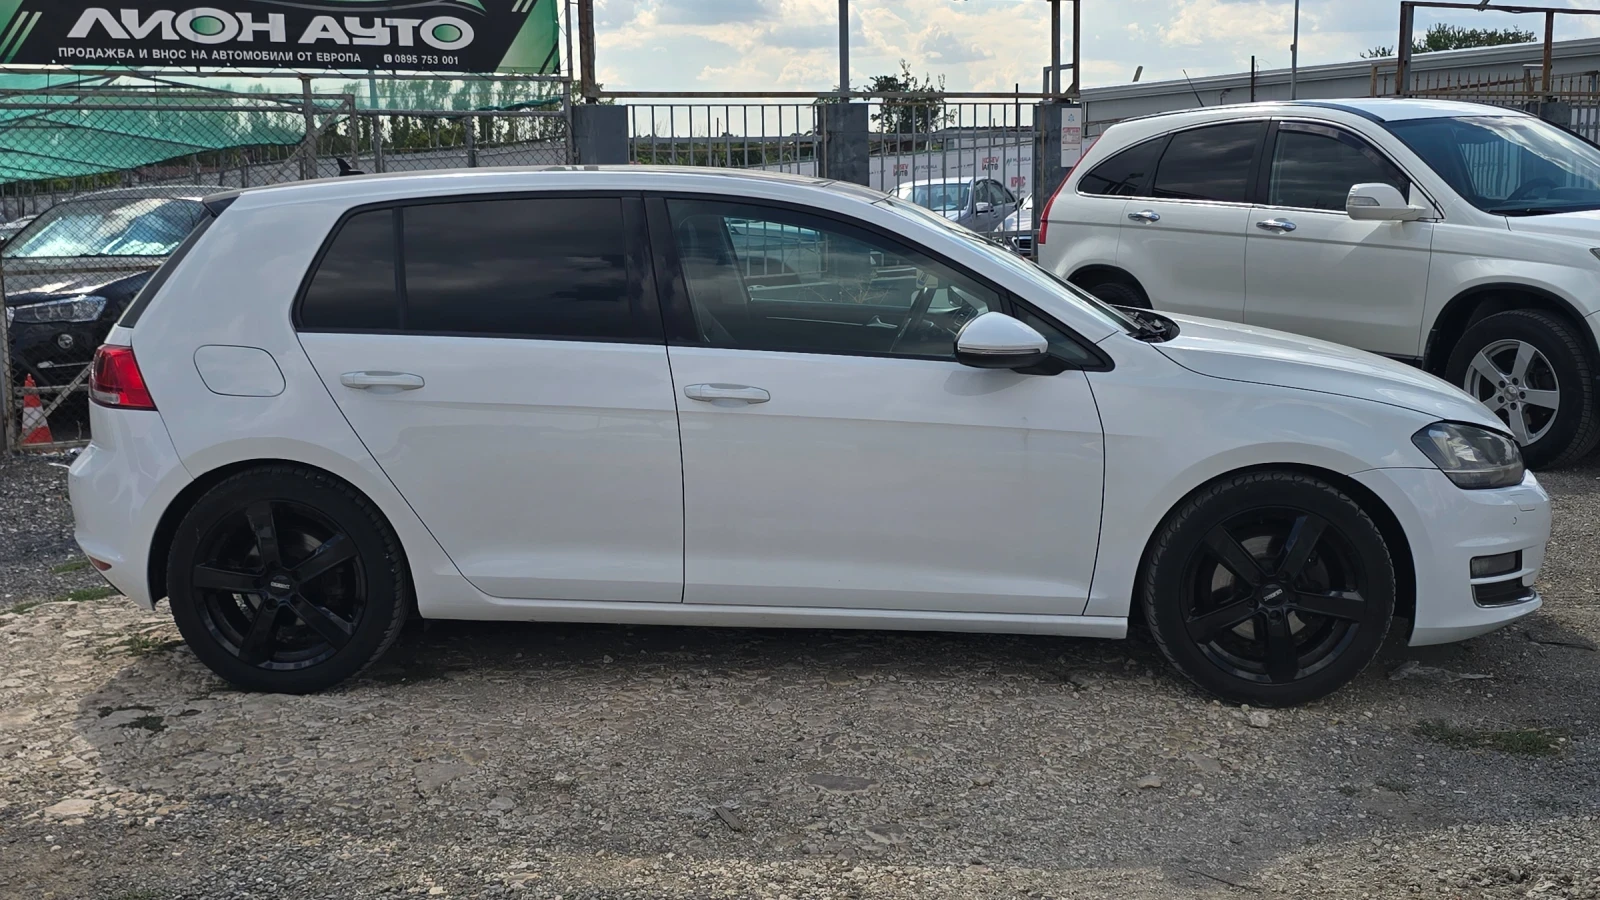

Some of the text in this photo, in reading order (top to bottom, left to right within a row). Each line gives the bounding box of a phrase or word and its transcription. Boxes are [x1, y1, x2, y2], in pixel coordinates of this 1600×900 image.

[66, 7, 474, 50] ЛИОН АУТО
[58, 47, 361, 63] ПРОДАЖБА И ВНОС НА АВТОМОБИЛИ ОТ ЕВРОПА
[394, 54, 459, 65] 0895 753 001
